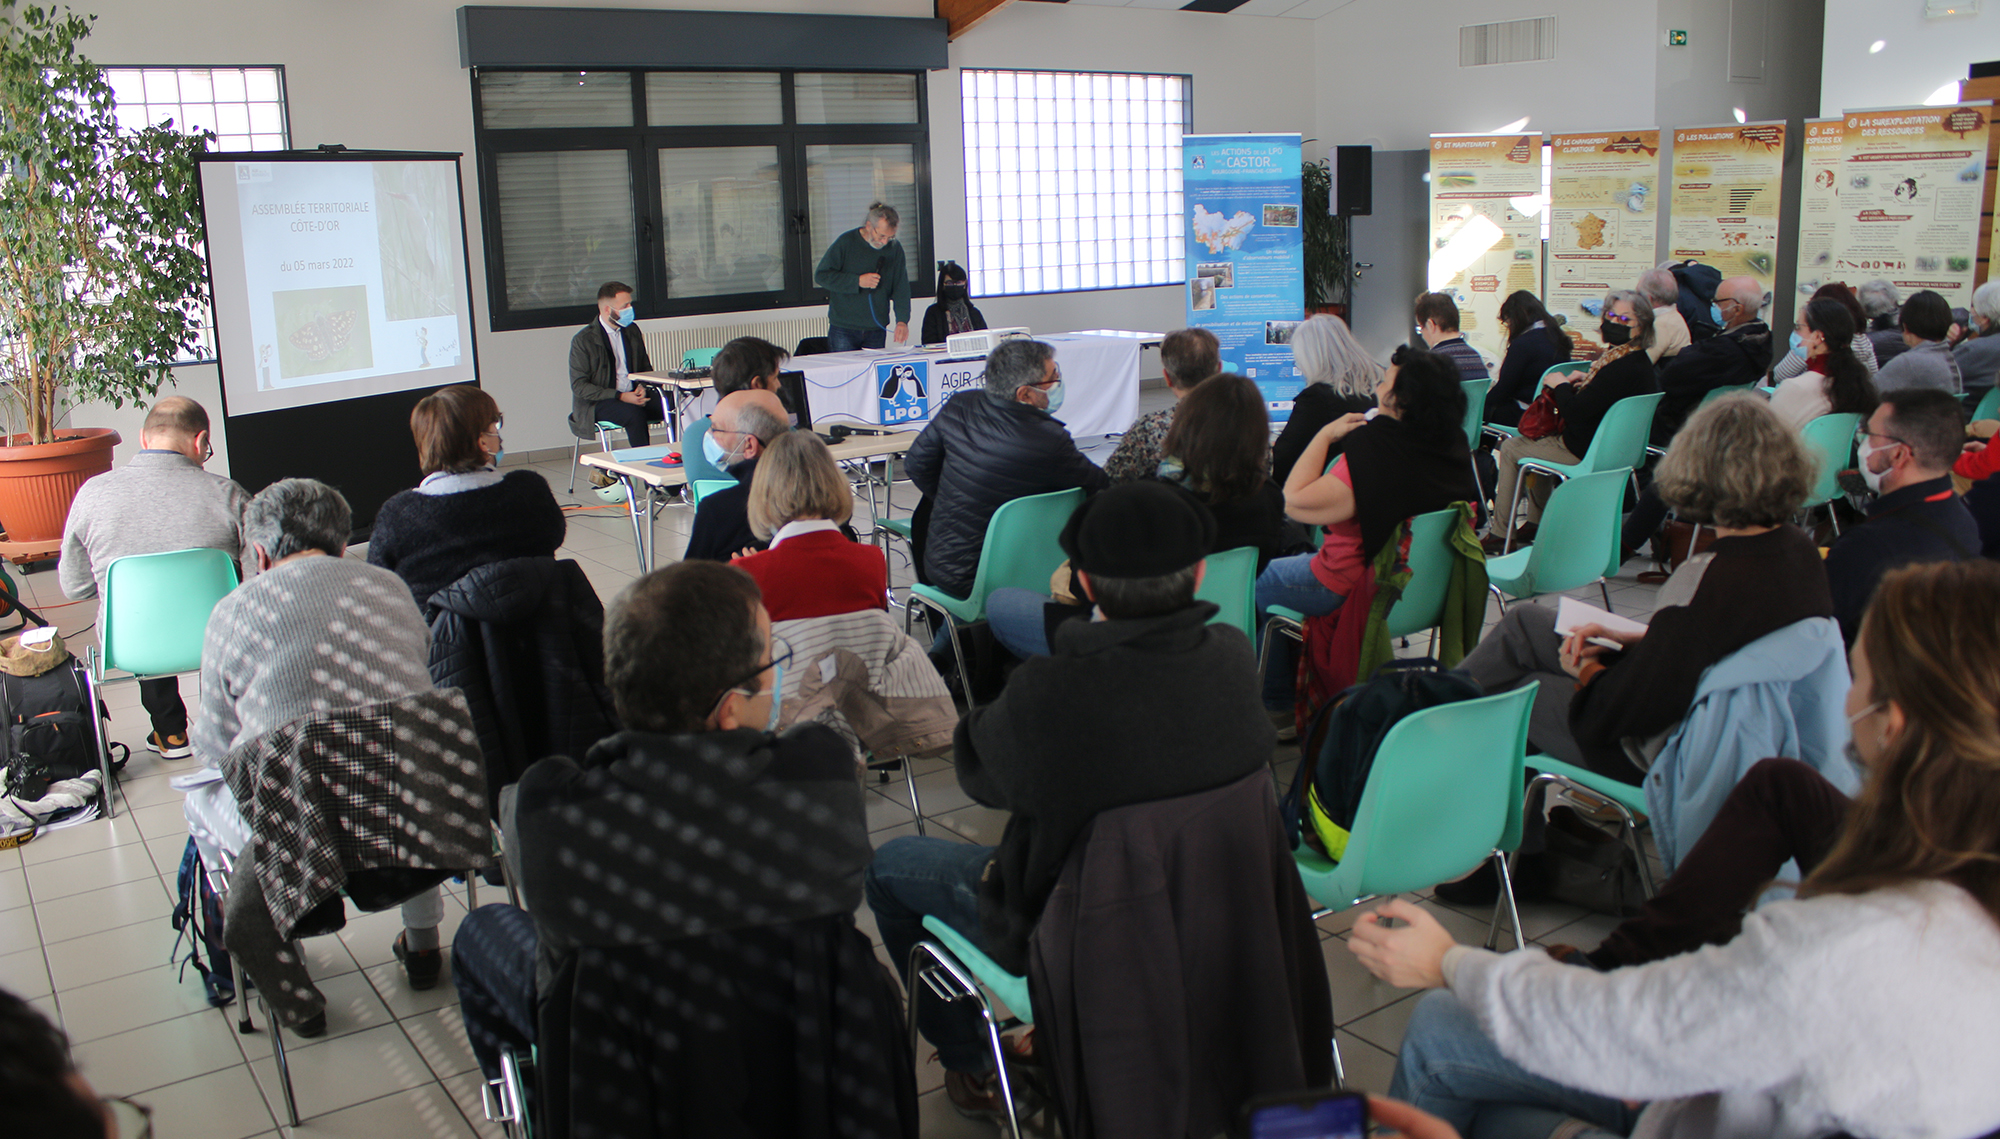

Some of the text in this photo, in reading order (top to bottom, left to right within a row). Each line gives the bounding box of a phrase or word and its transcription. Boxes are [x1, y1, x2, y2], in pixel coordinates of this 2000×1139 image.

[1860, 118, 1870, 126] LA
[1872, 116, 1940, 126] SUREXPLOITATION
[1878, 126, 1924, 136] RESSOURCES
[1227, 156, 1271, 168] CASTOR
[252, 201, 369, 215] ASSEMBLÉE TERRITORIALE
[290, 219, 340, 232] CÔTE-D'OR
[280, 258, 354, 272] du 05 mars 2022
[941, 371, 971, 389] AGIR
[885, 406, 922, 421] LPO
